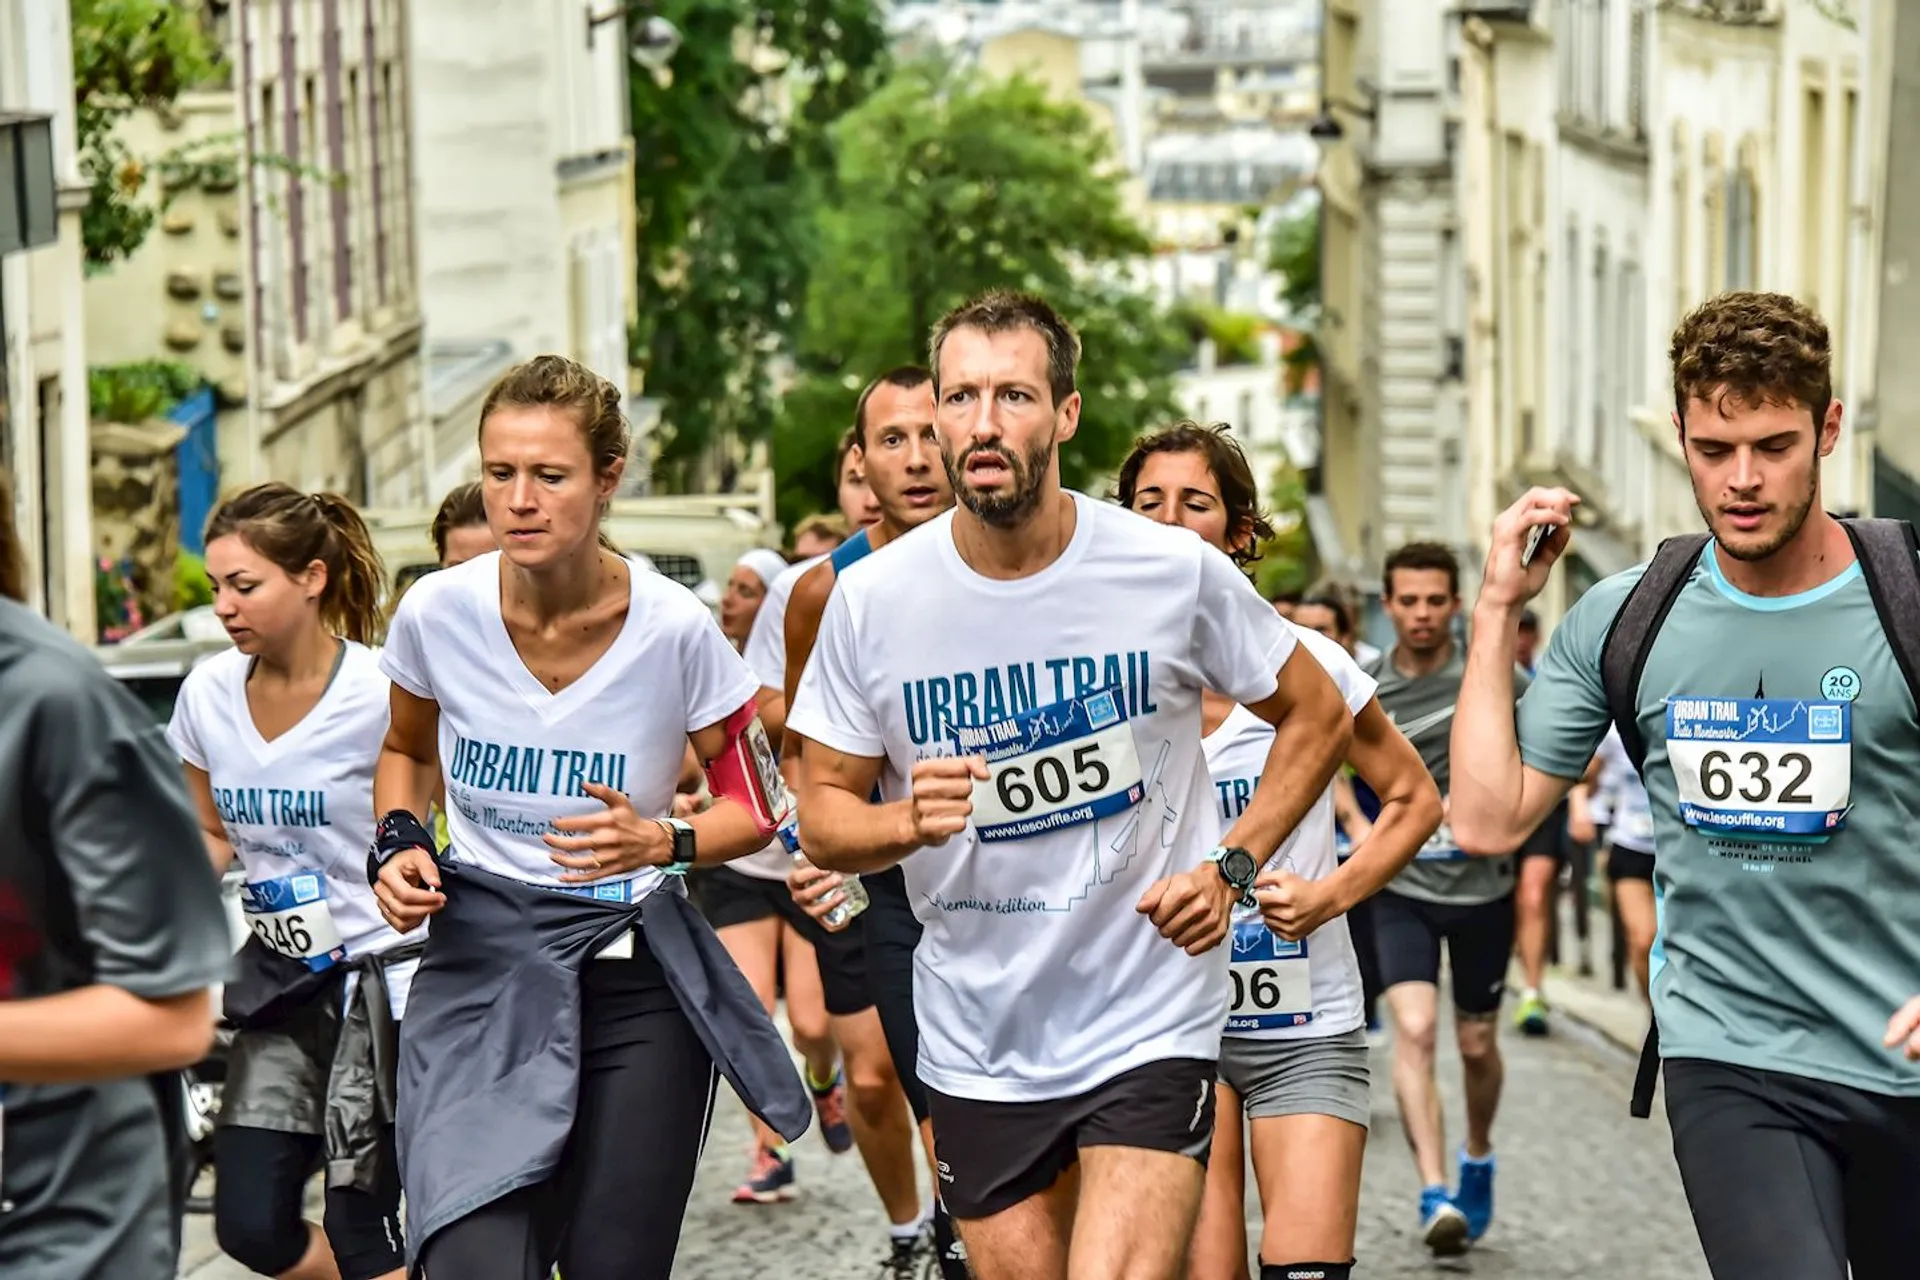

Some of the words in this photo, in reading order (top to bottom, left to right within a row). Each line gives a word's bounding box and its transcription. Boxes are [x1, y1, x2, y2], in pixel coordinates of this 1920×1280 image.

[1828, 688, 1852, 699] ANS
[1829, 674, 1853, 688] 20
[903, 662, 1038, 745] URBAN
[1674, 700, 1709, 720] URBAN
[1710, 701, 1740, 722] TRAIL
[987, 718, 1023, 744] TRAIL
[451, 736, 544, 795] URBAN
[551, 749, 630, 799] TRAIL
[996, 743, 1110, 814] 605
[1699, 750, 1813, 804] 632
[267, 789, 332, 828] TRAIL
[1685, 808, 1785, 829] www.lesouffle.org
[984, 805, 1094, 839] www.lesouffle.org
[1708, 840, 1757, 850] MARATHON
[1720, 851, 1744, 860] MONT
